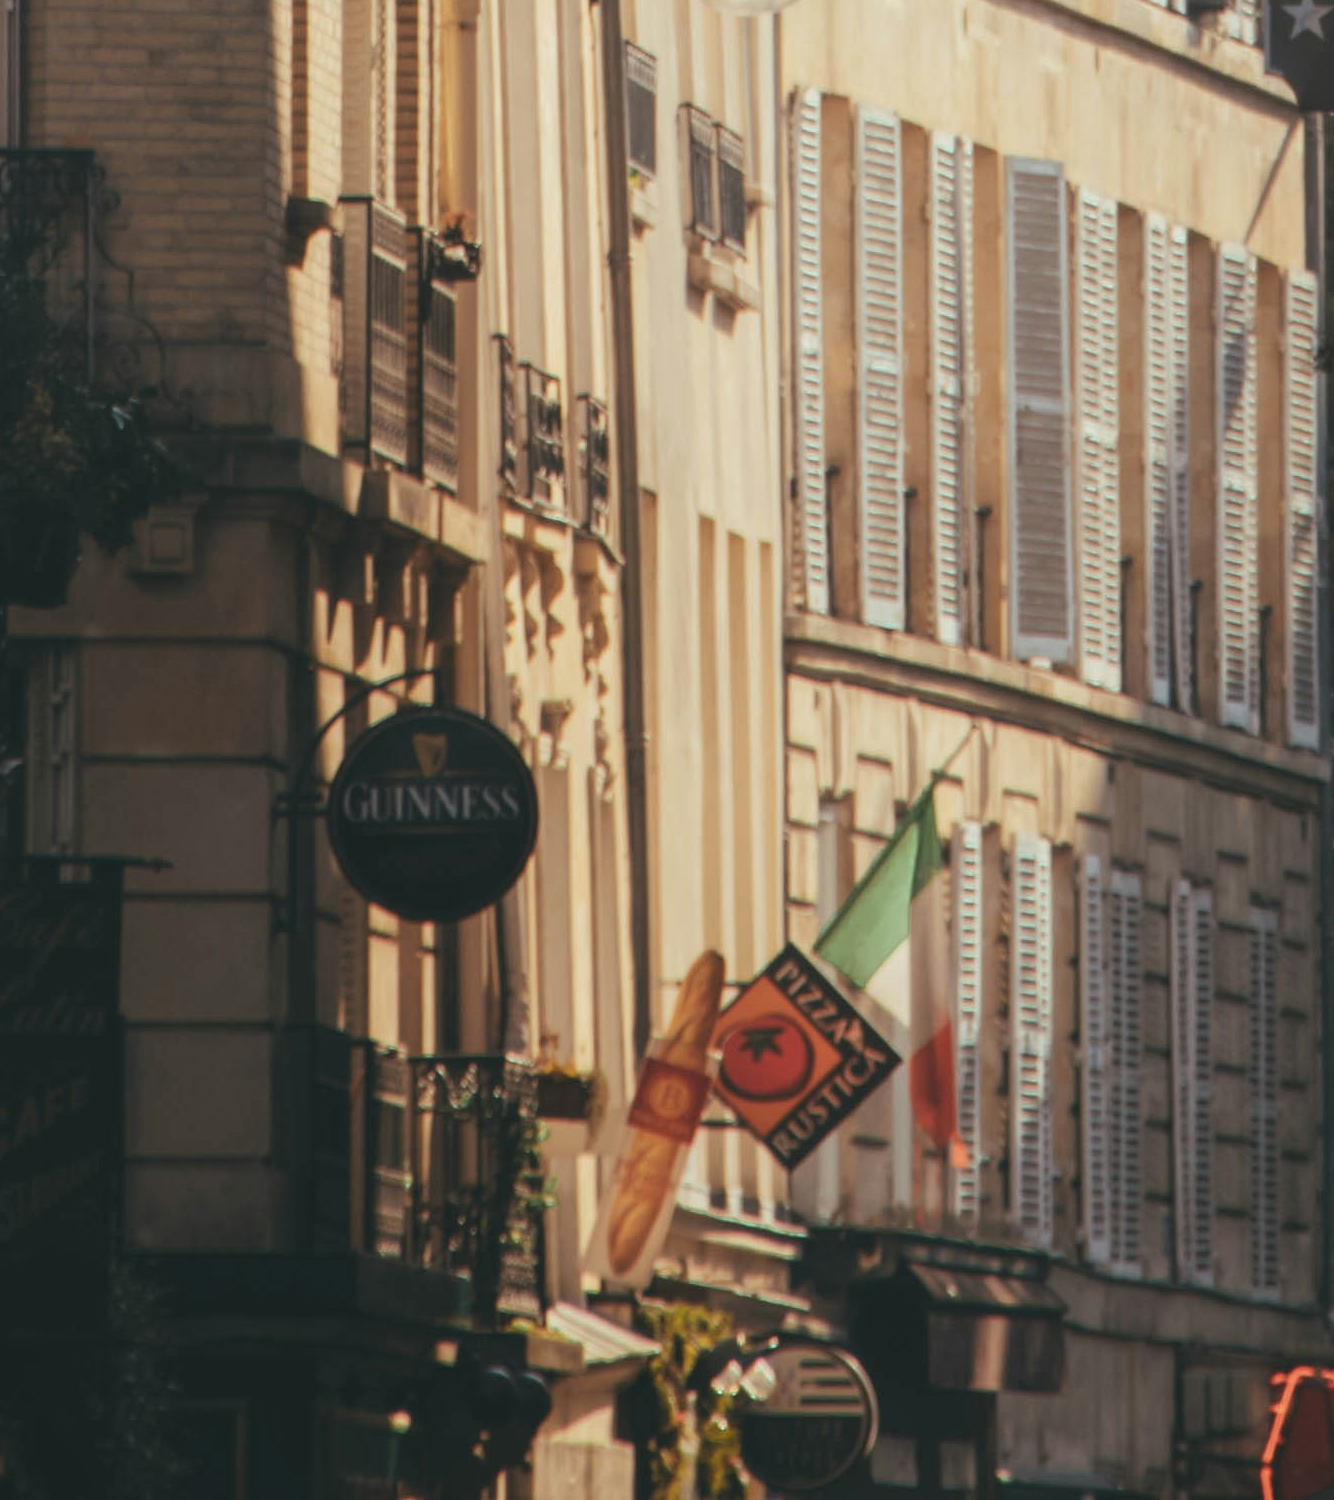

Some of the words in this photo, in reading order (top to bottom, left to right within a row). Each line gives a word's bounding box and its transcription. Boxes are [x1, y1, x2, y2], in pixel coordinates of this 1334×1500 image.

[343, 780, 521, 823] GUINNESS
[773, 958, 866, 1053] PIZZA
[772, 1046, 889, 1158] RUSTICA
